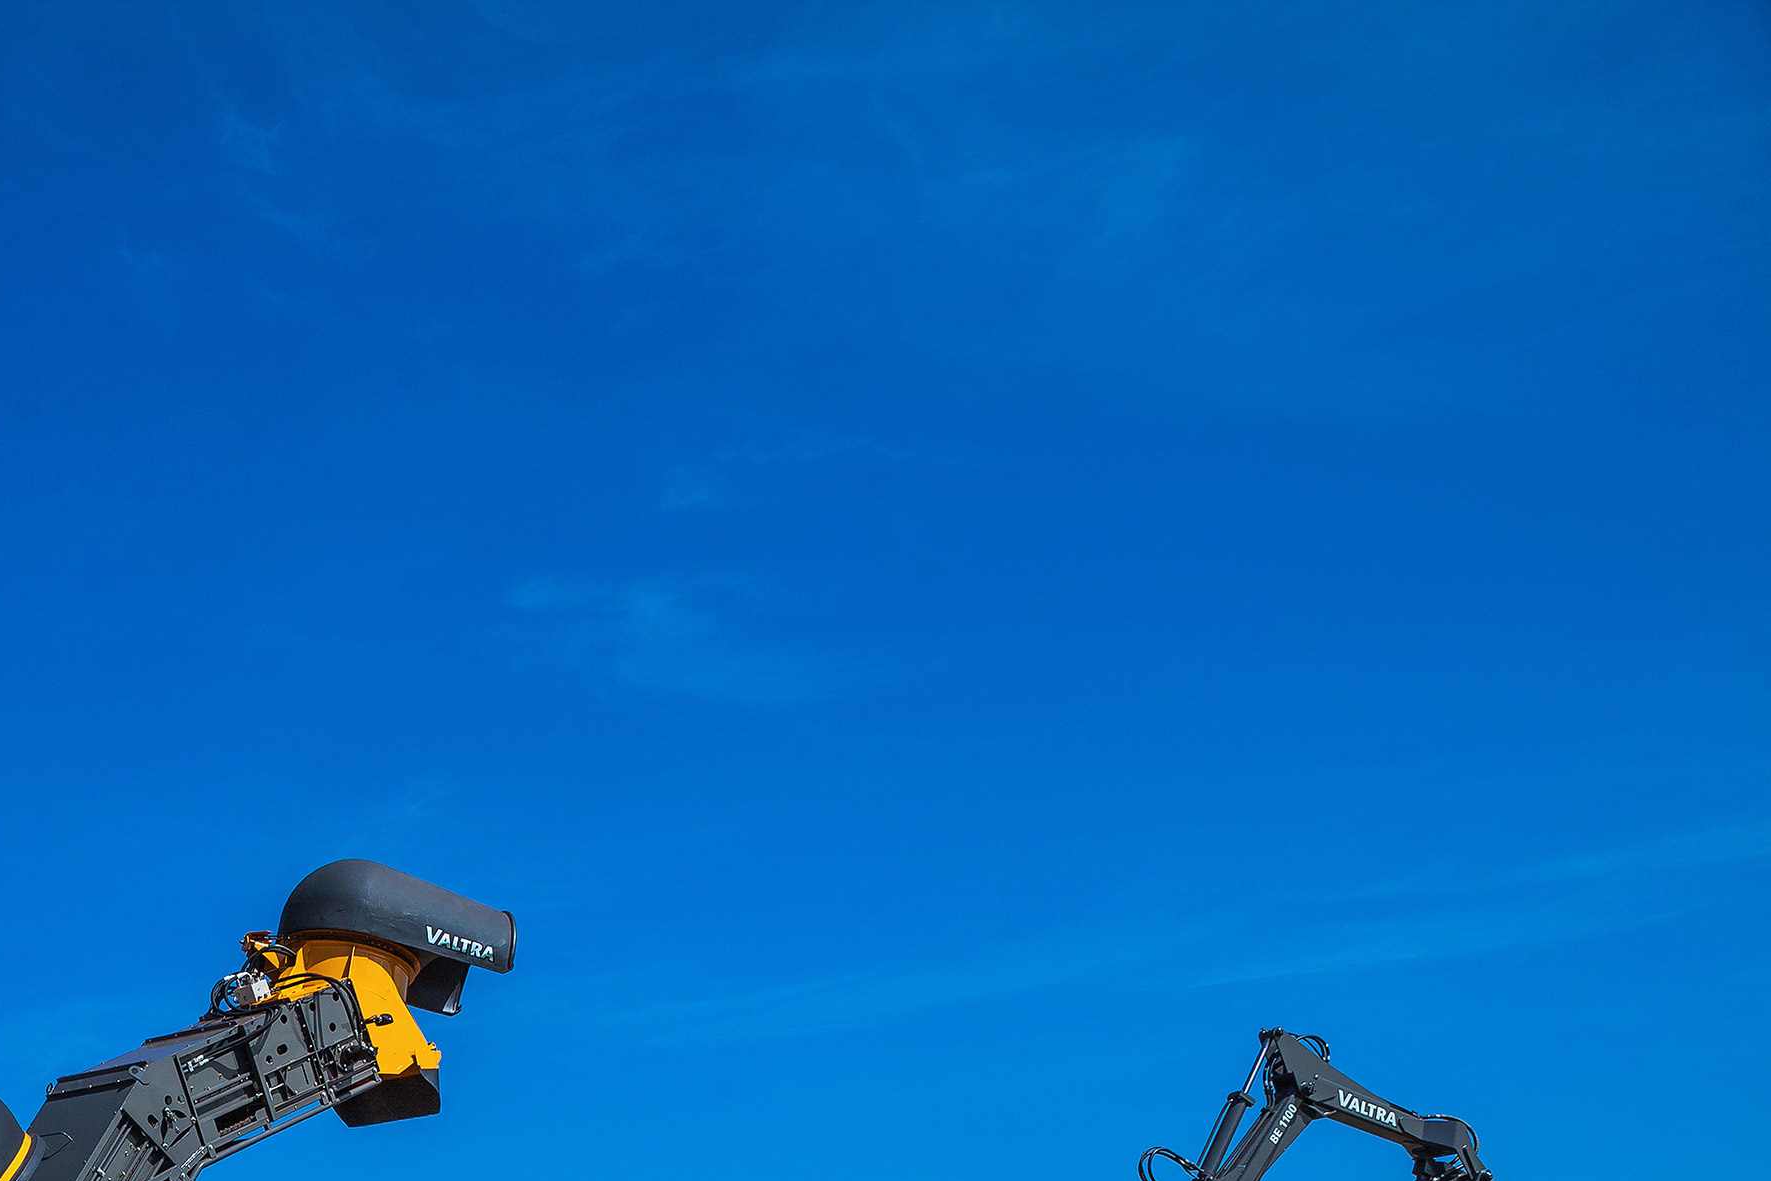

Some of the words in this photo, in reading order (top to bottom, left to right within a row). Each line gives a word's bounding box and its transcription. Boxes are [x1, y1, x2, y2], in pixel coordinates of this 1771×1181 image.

[425, 925, 495, 962] VALTRA
[1269, 1127, 1284, 1145] BE
[1279, 1103, 1298, 1129] 1100
[1338, 1089, 1398, 1127] VALTRA
